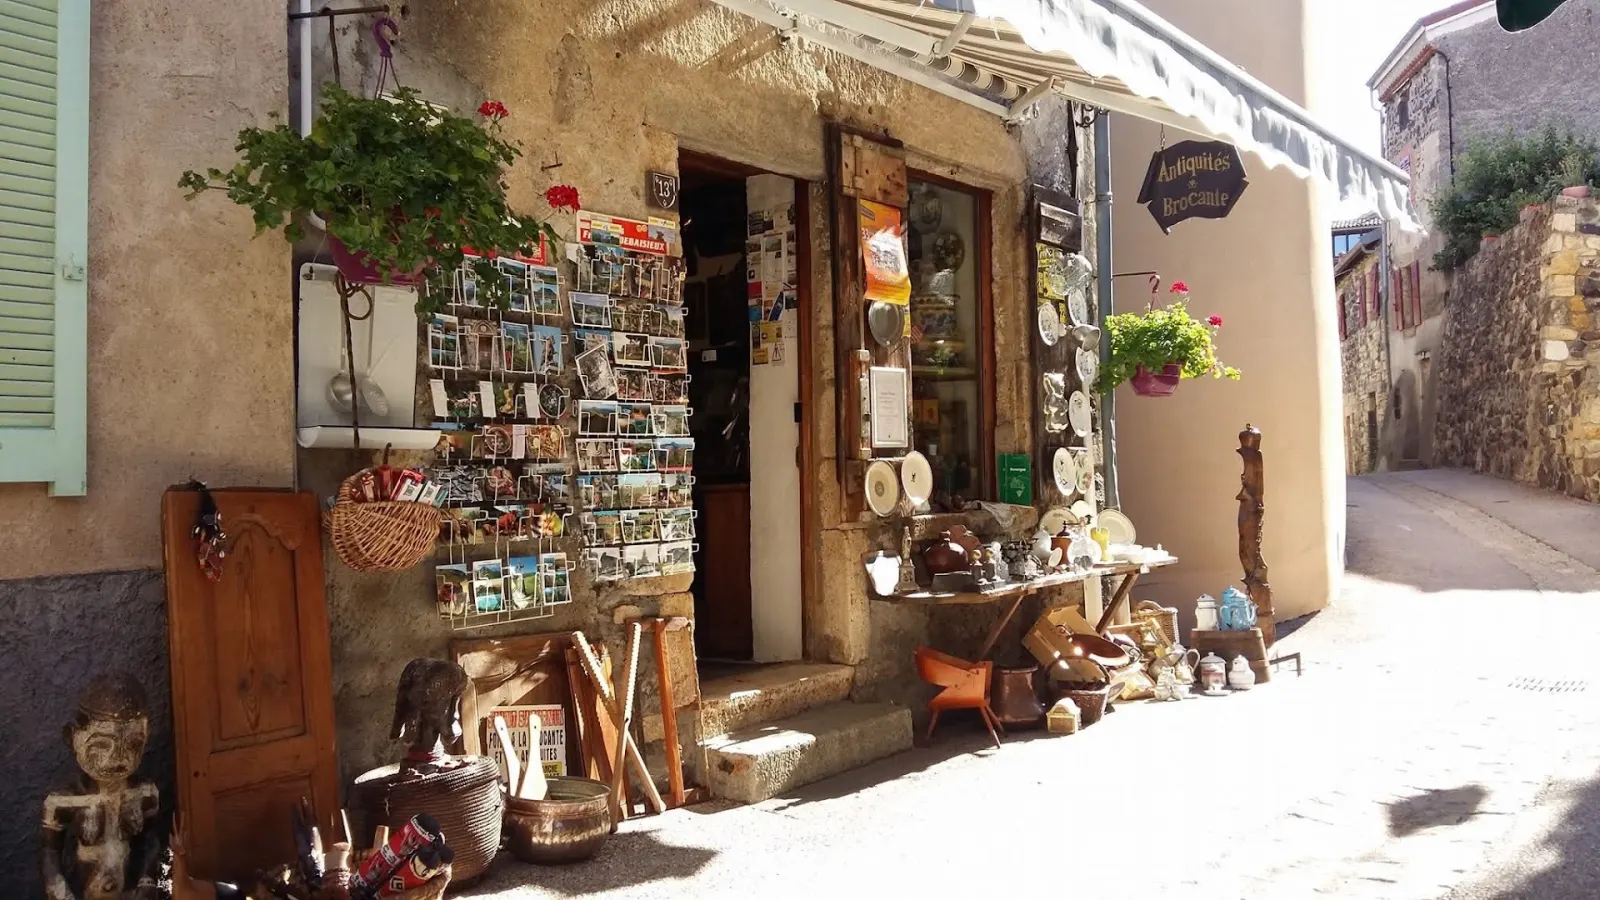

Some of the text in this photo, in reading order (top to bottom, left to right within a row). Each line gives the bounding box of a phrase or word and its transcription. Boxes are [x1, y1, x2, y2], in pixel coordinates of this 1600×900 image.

[1157, 152, 1231, 182] Antiquités
[658, 181, 671, 198] 13
[1163, 188, 1230, 216] Brocante
